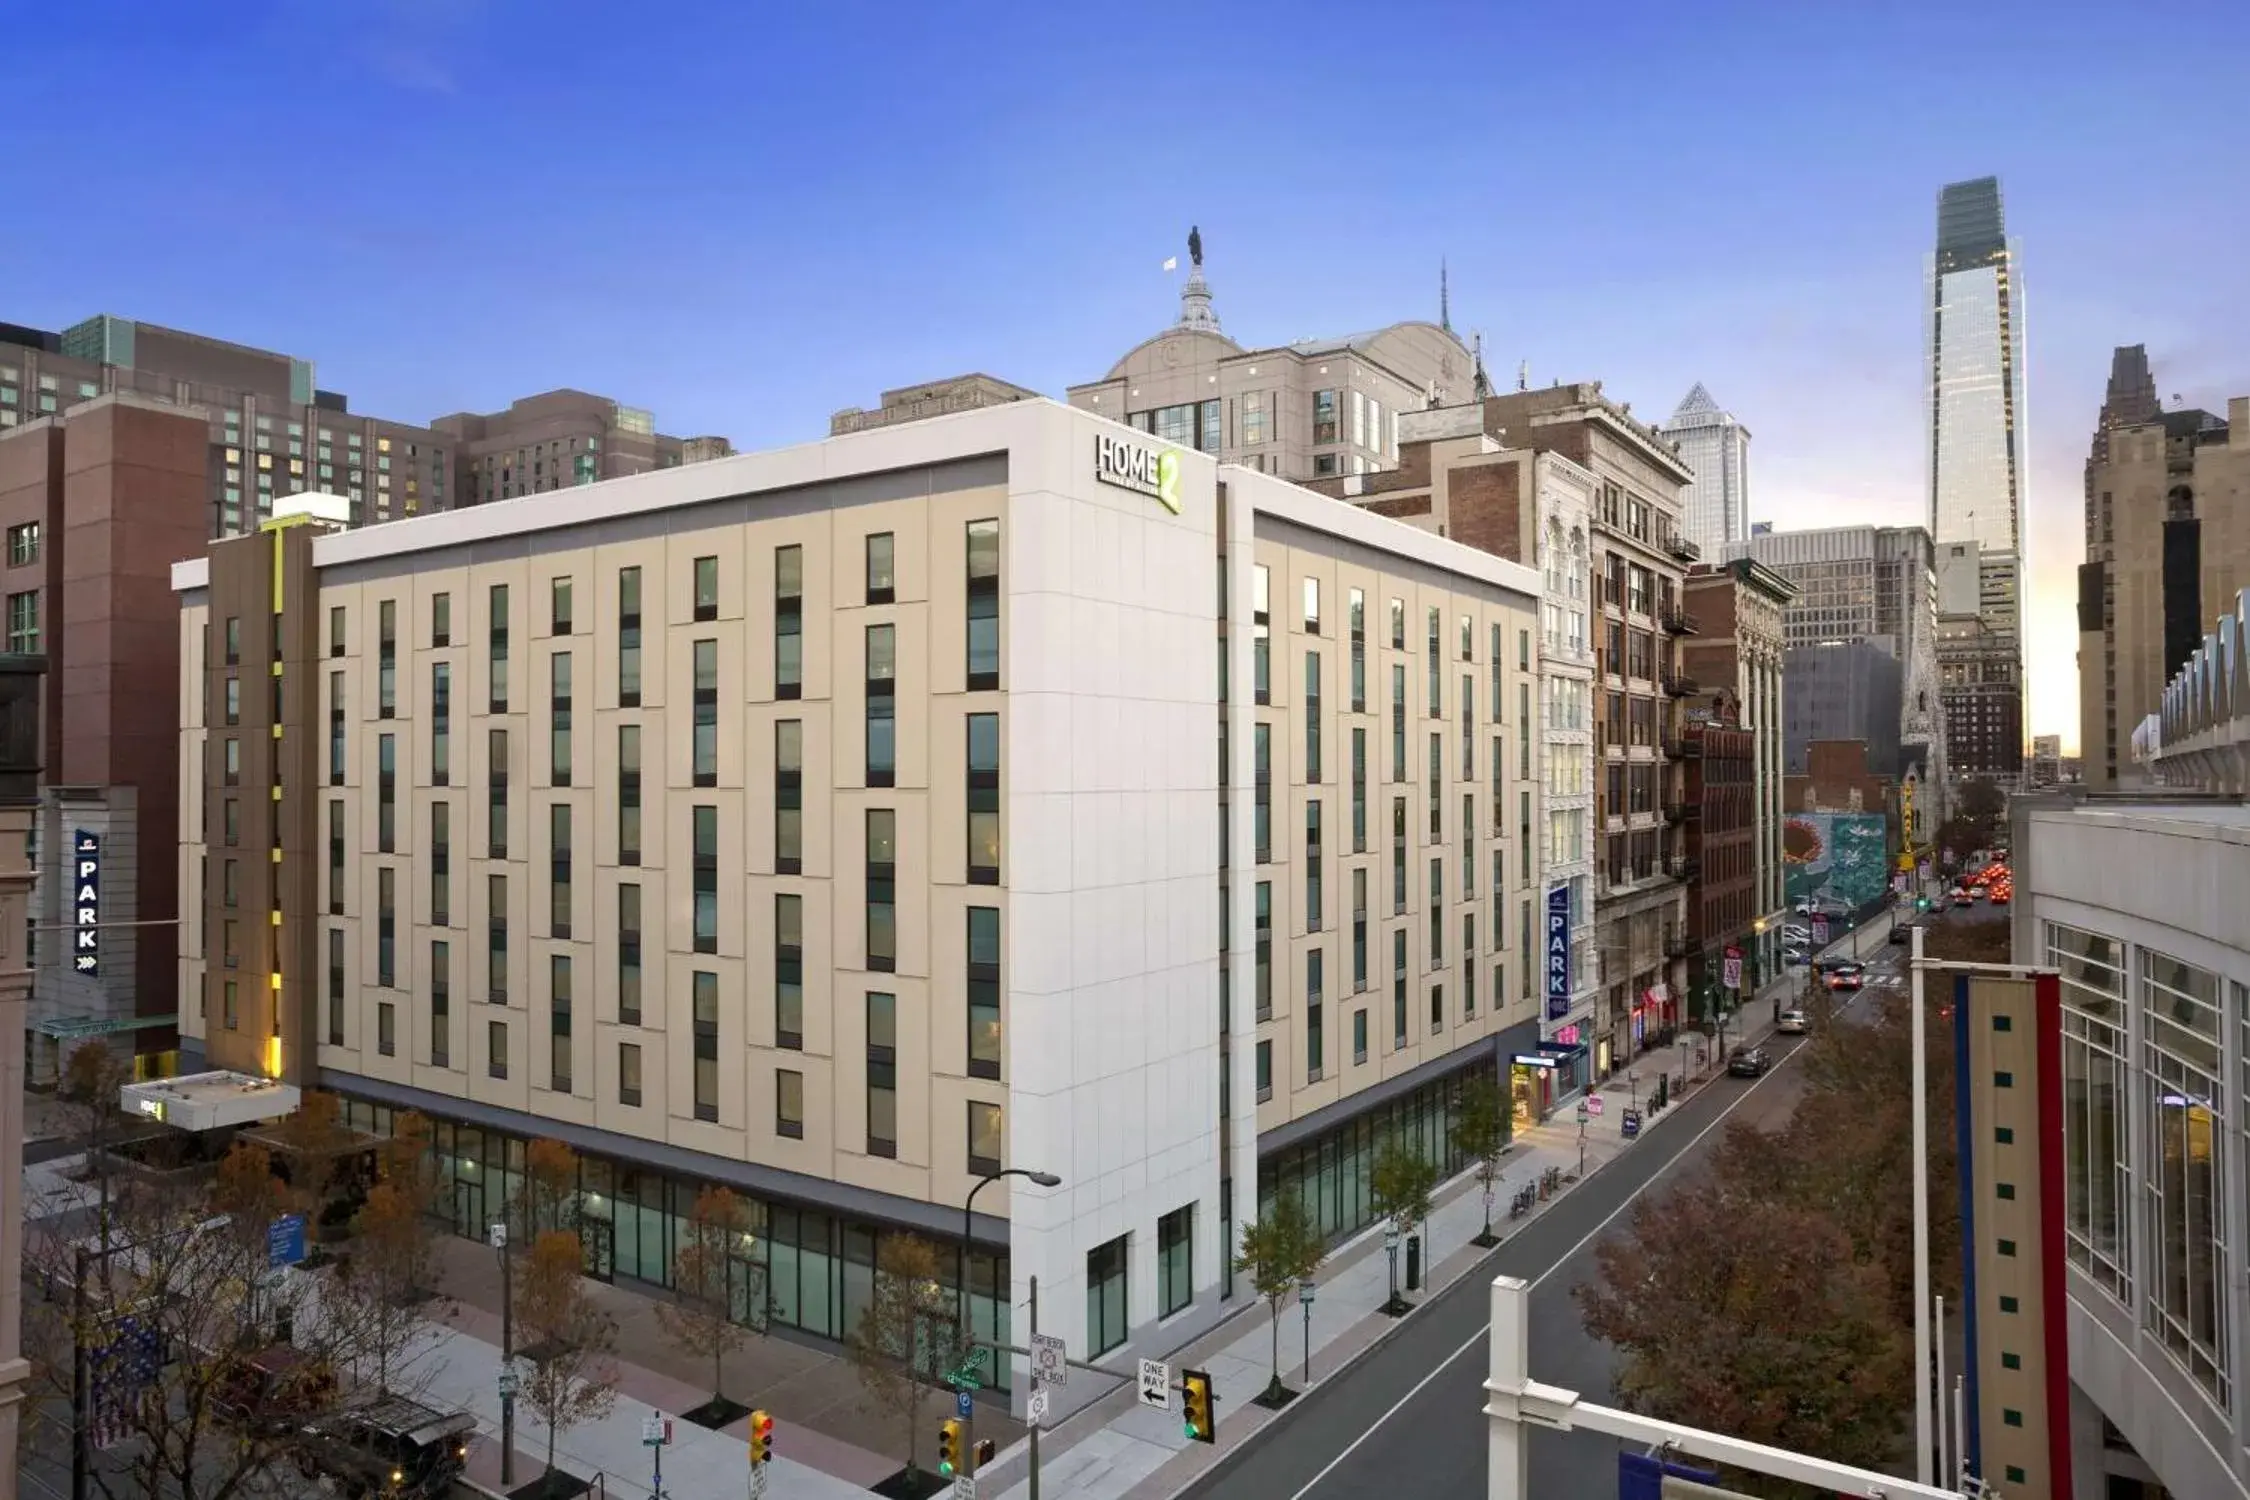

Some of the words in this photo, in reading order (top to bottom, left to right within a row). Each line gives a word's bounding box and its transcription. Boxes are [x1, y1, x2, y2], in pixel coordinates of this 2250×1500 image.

[78, 861, 97, 948] PARK
[1550, 915, 1565, 993] PARK
[1144, 1361, 1164, 1375] ONE
[1144, 1376, 1165, 1388] WAY
